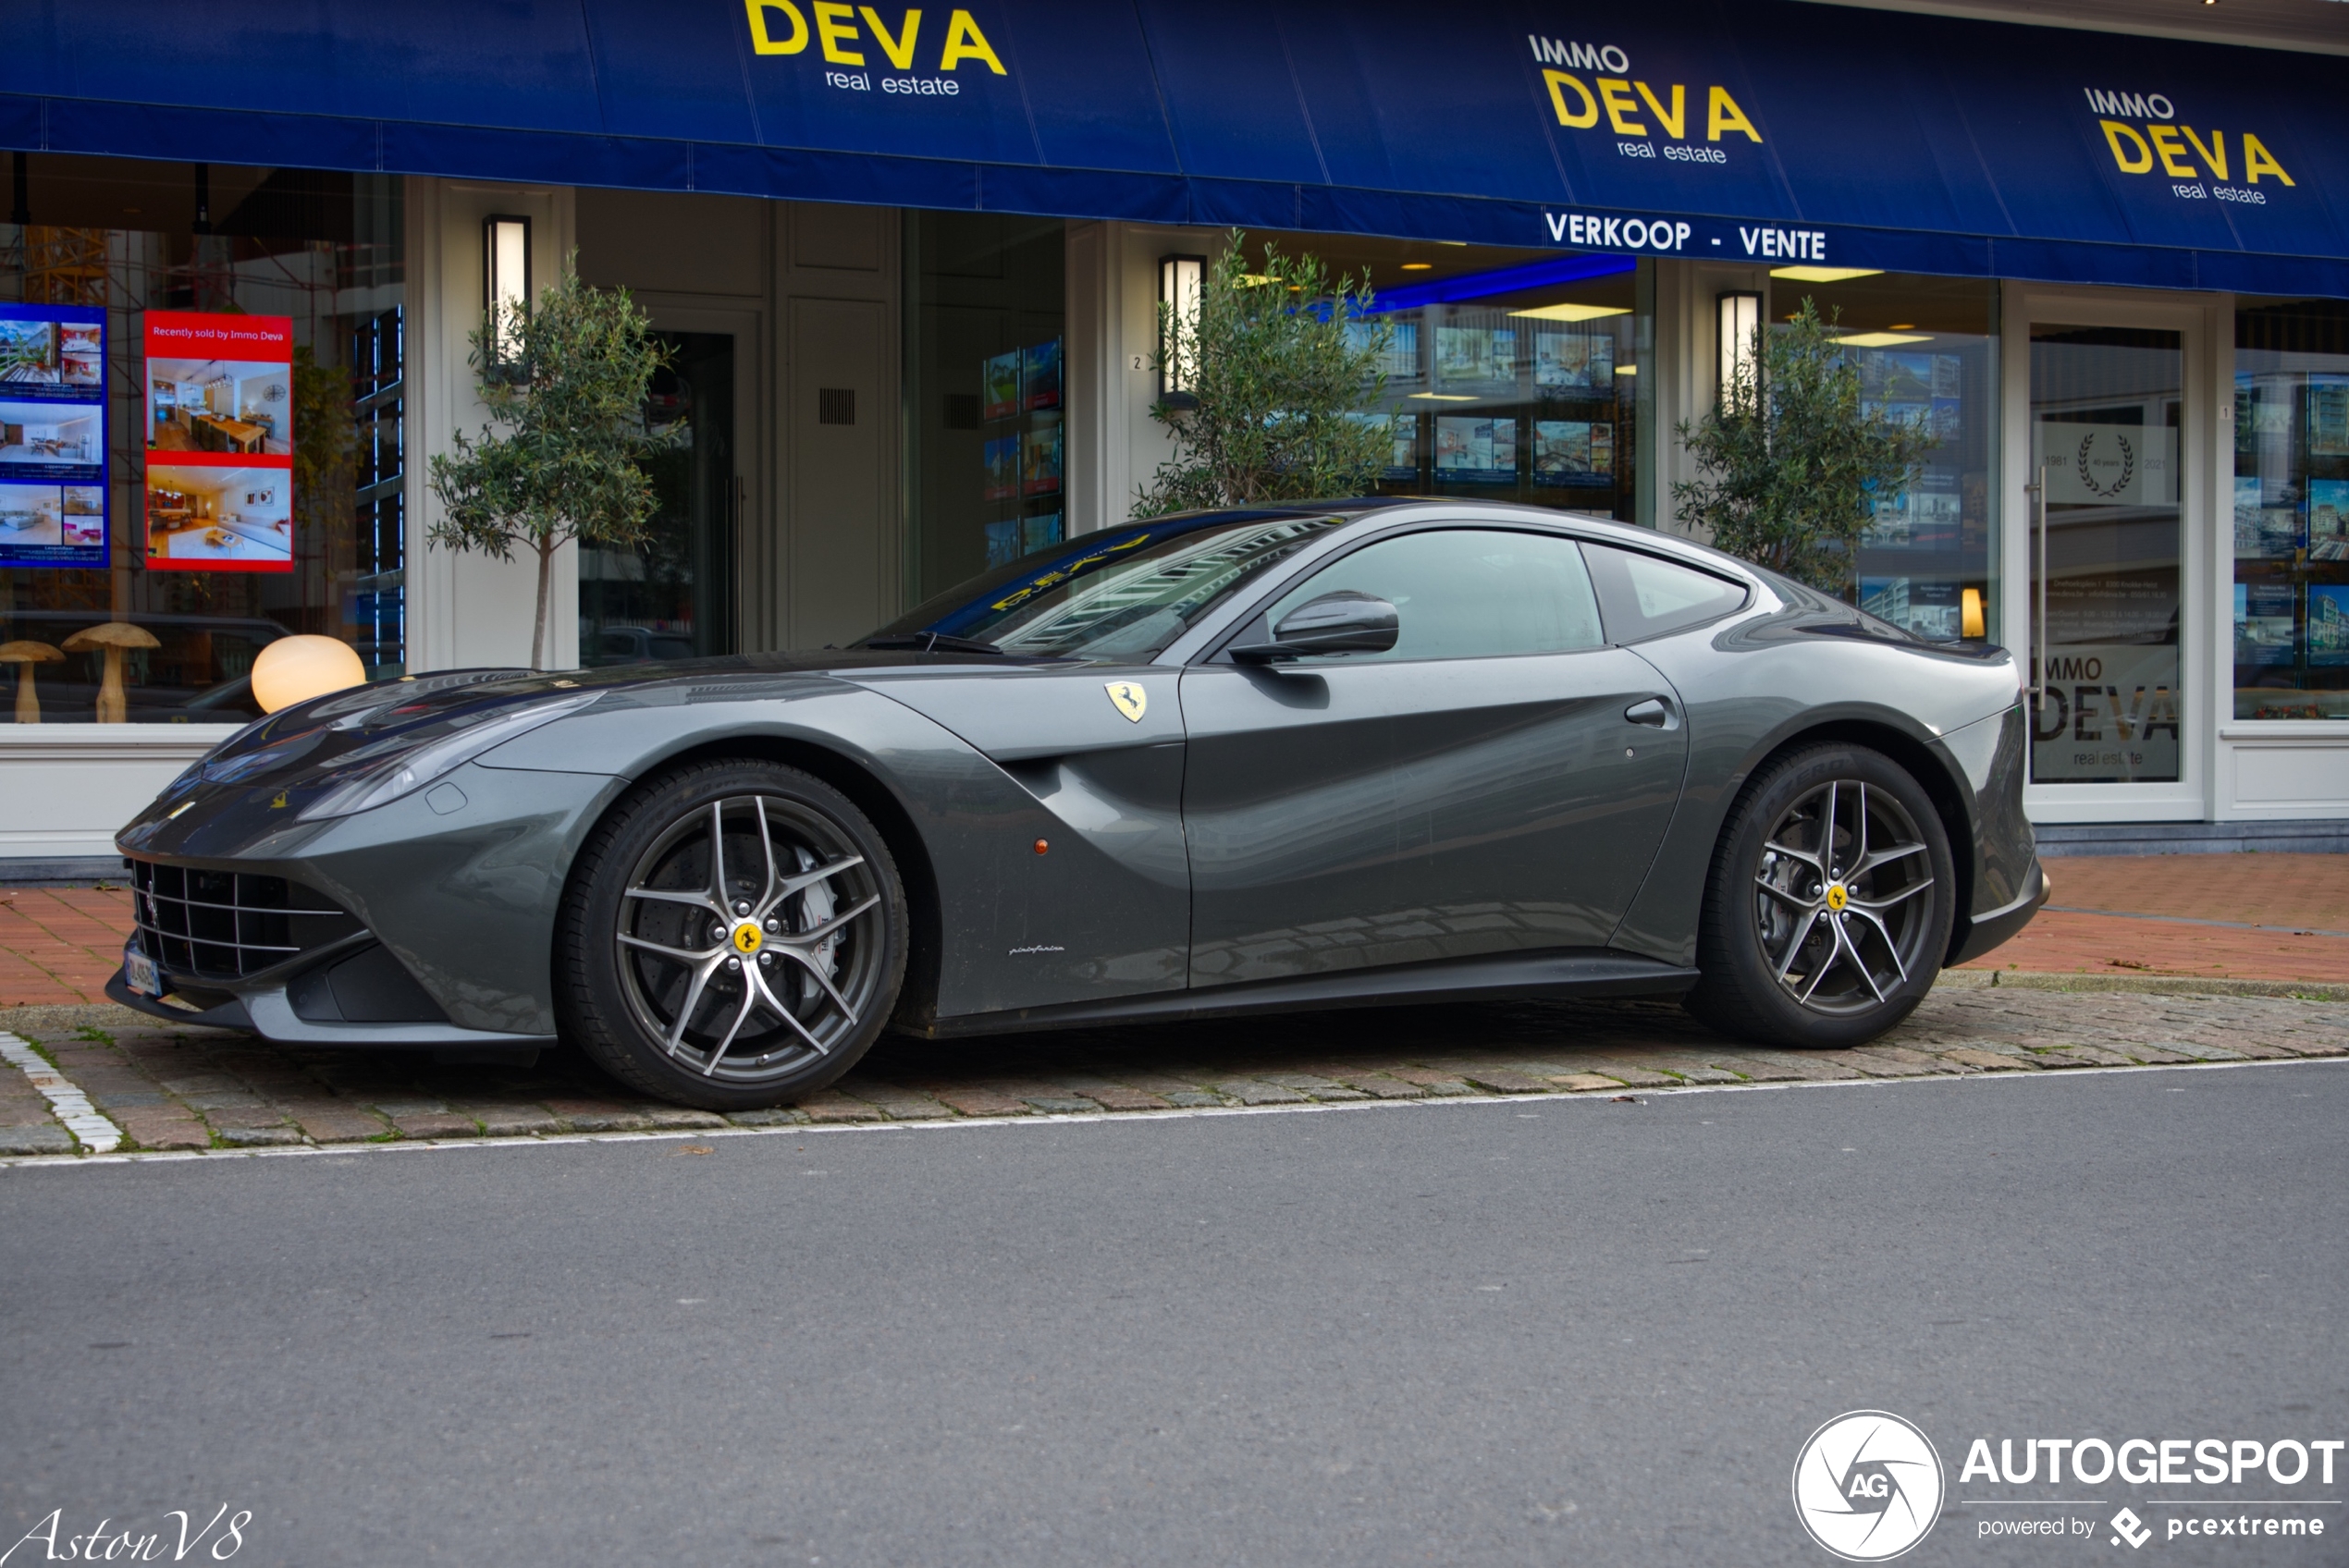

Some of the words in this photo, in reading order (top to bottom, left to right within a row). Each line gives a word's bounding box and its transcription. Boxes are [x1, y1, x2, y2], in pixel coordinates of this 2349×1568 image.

[745, 0, 1008, 76] DEVA
[1529, 34, 1629, 74] IMMO
[826, 71, 870, 91] real
[881, 77, 959, 95] estate
[1542, 68, 1763, 143] DEVA
[2084, 88, 2174, 119] IMMO
[1617, 141, 1656, 158] real
[1664, 144, 1727, 164] estate
[2099, 119, 2296, 187] DEVA
[2171, 182, 2208, 199] real
[2213, 186, 2266, 204] estate
[1545, 213, 1691, 251] VERKOOP
[1740, 227, 1826, 260] VENTE
[154, 326, 193, 339] Recently
[195, 329, 215, 338] sold
[217, 329, 228, 340] by
[230, 330, 259, 340] Immo
[260, 331, 283, 341] Deva
[1134, 356, 1141, 370] 2
[2045, 456, 2068, 467] 1981
[2092, 459, 2101, 467] 40
[2102, 459, 2120, 468] years
[2144, 459, 2166, 470] 2021
[2121, 581, 2158, 589] Knokke-Heist
[2033, 686, 2179, 741] DEVA
[2073, 752, 2099, 766] real
